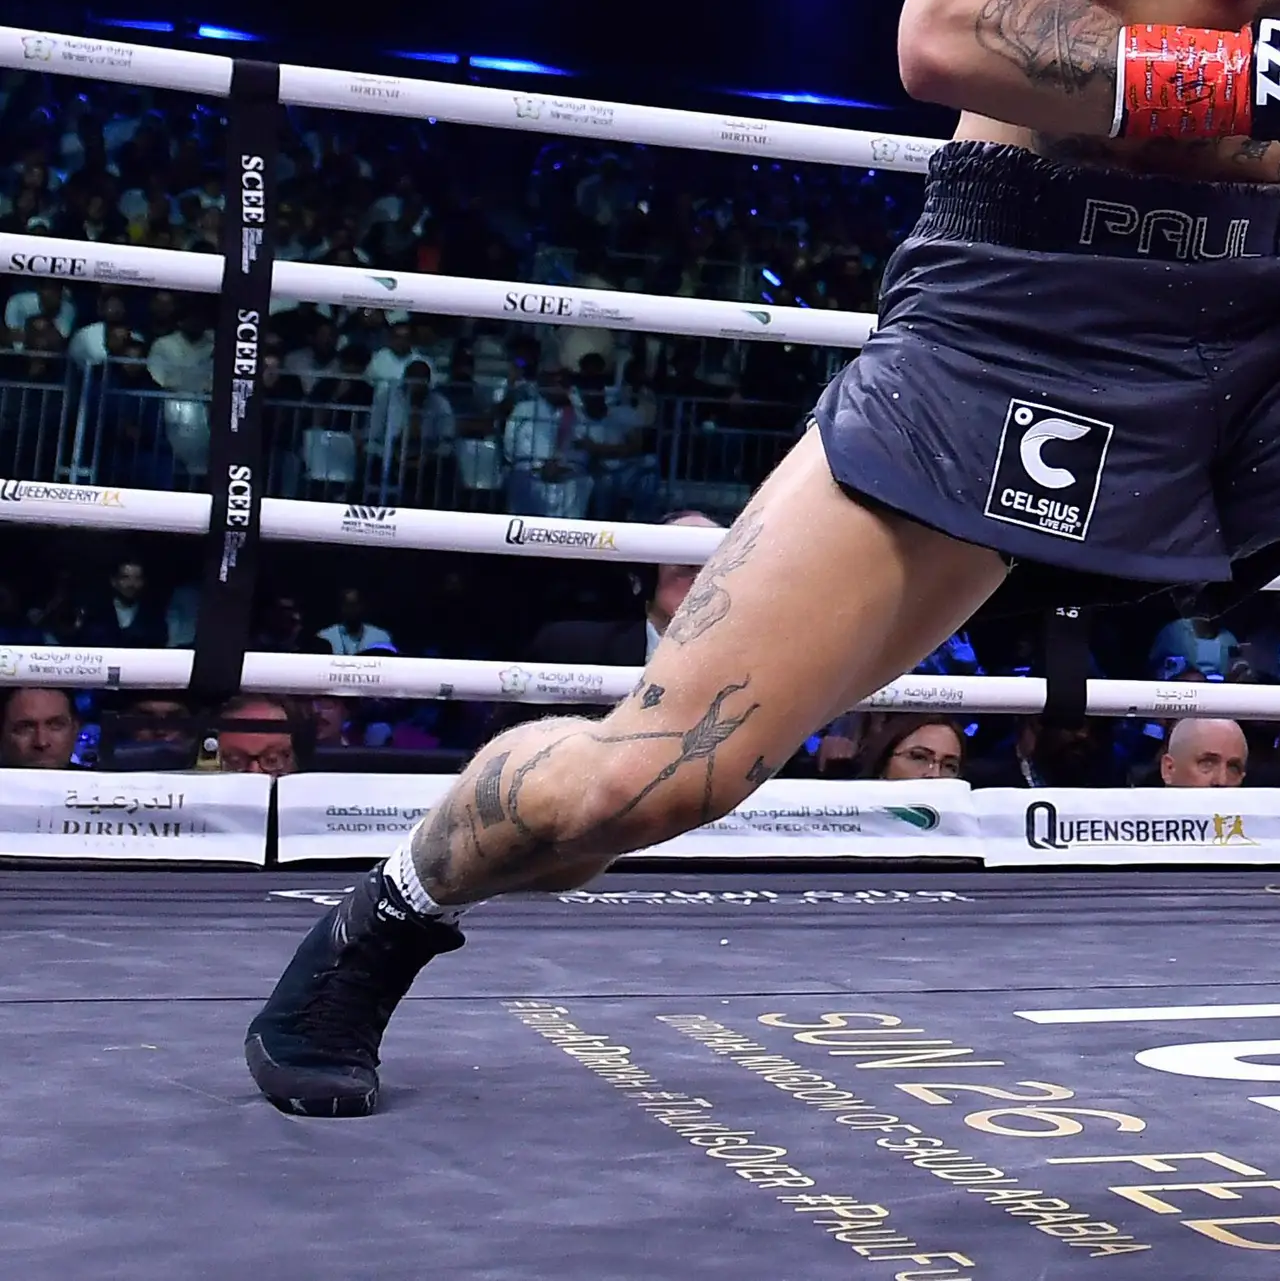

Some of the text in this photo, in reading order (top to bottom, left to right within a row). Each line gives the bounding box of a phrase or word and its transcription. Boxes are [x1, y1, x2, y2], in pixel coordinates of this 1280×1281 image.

[242, 155, 265, 223] SCEE
[1079, 198, 1262, 261] PAUL
[9, 253, 87, 277] SCEE
[503, 291, 573, 317] SCEE
[234, 309, 260, 375] SCEE
[1, 479, 101, 501] QUEENSBERRY
[227, 465, 251, 526] SCEE
[1001, 488, 1080, 524] CELSIUS
[505, 518, 598, 548] QUEENSBERRY
[1039, 517, 1076, 533] LIVE FIT
[65, 790, 185, 815] الدرعية
[63, 820, 181, 837] DIRIYAH
[327, 823, 415, 832] SAUDI BOXI
[1026, 800, 1210, 850] QUEENSBERRY
[730, 1055, 875, 1111] KINGDOM
[757, 1011, 1005, 1068] SUN
[894, 1080, 1147, 1138] 26
[834, 1113, 922, 1136] OF
[875, 1136, 1019, 1186] SAUDI
[967, 1187, 1152, 1258] ARABIA
